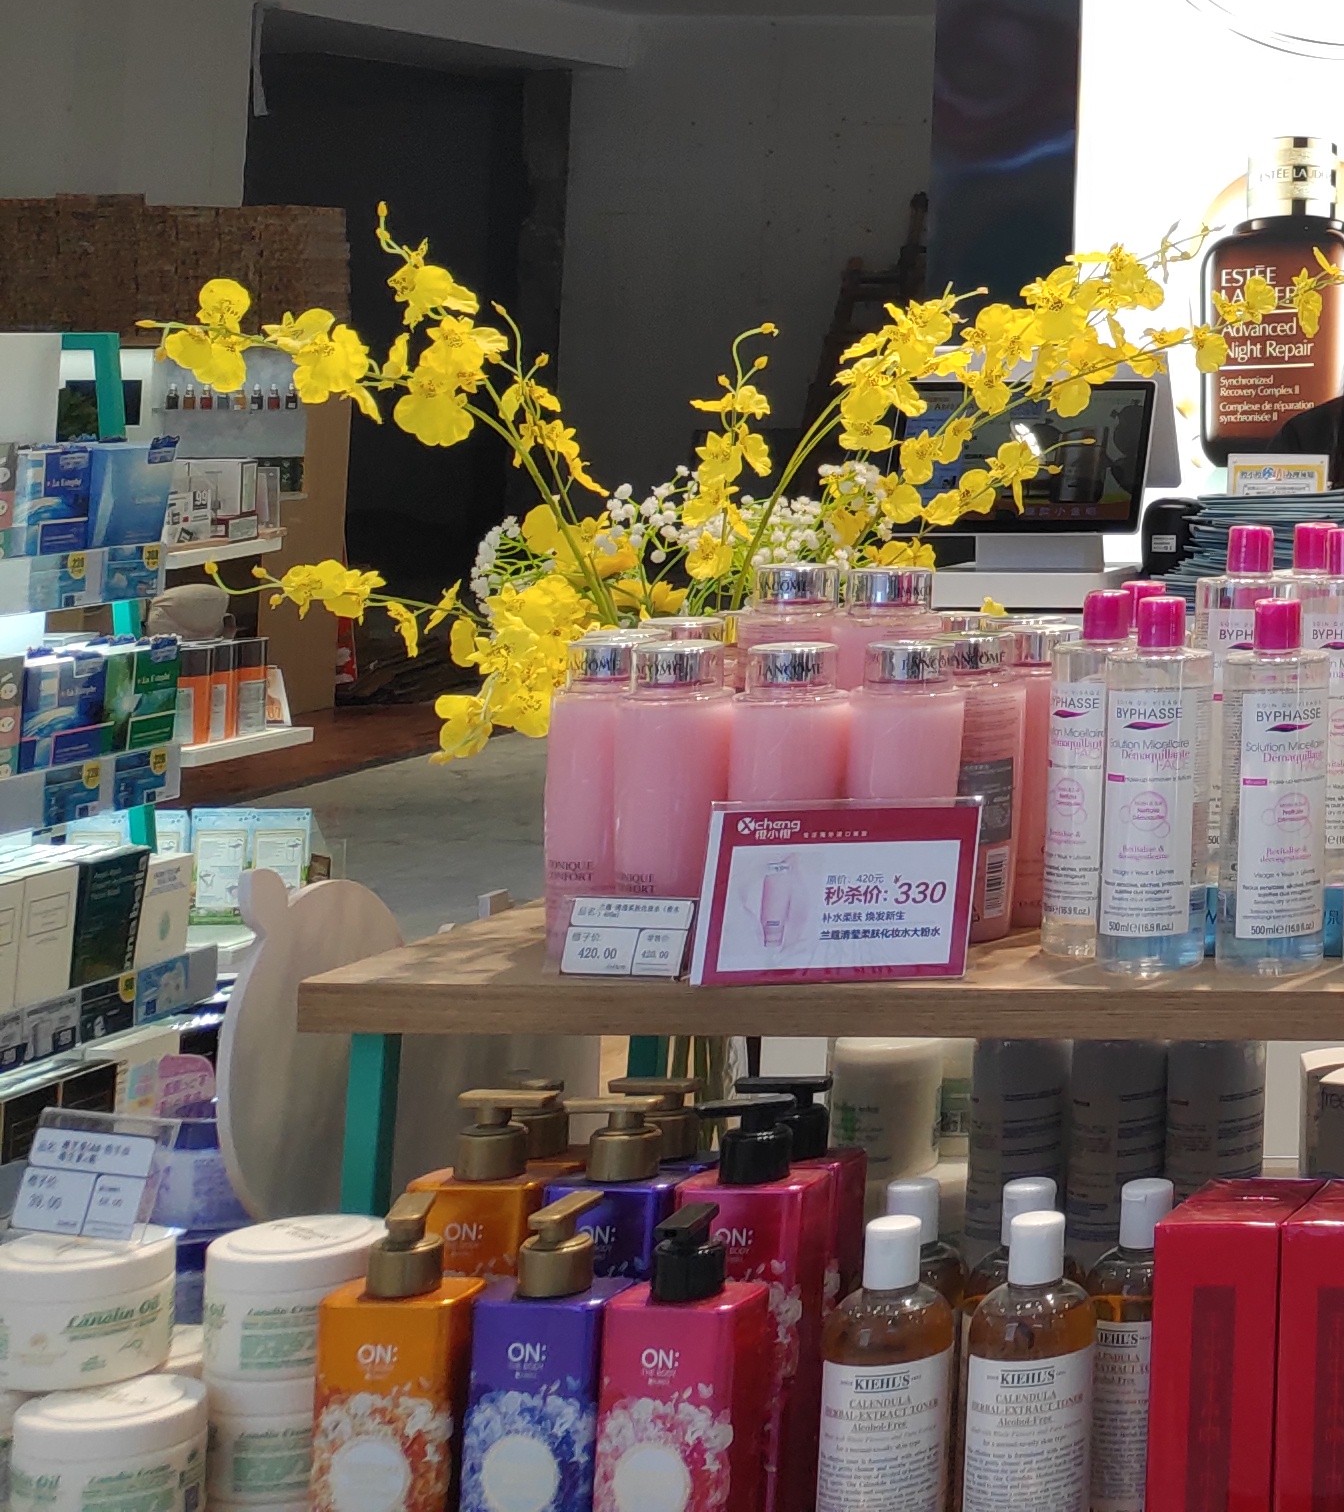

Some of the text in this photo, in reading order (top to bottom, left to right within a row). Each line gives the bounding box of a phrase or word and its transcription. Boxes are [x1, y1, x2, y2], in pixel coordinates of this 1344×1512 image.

[1221, 287, 1296, 304] LAER
[1222, 317, 1296, 337] Advanced
[1266, 340, 1314, 361] Repair
[1220, 375, 1273, 386] Synchronized
[1220, 387, 1256, 397] Recovery
[1258, 386, 1292, 397] Complex
[1220, 402, 1260, 414] Complexe
[1262, 401, 1272, 410] de
[1219, 629, 1254, 640] BYPH
[1116, 707, 1183, 719] BYPHASSE
[1256, 707, 1321, 722] BYPHASSE
[1246, 740, 1285, 752] Solution
[855, 1374, 910, 1391] KIEHL'S
[1001, 1369, 1055, 1385] KIEHL'S
